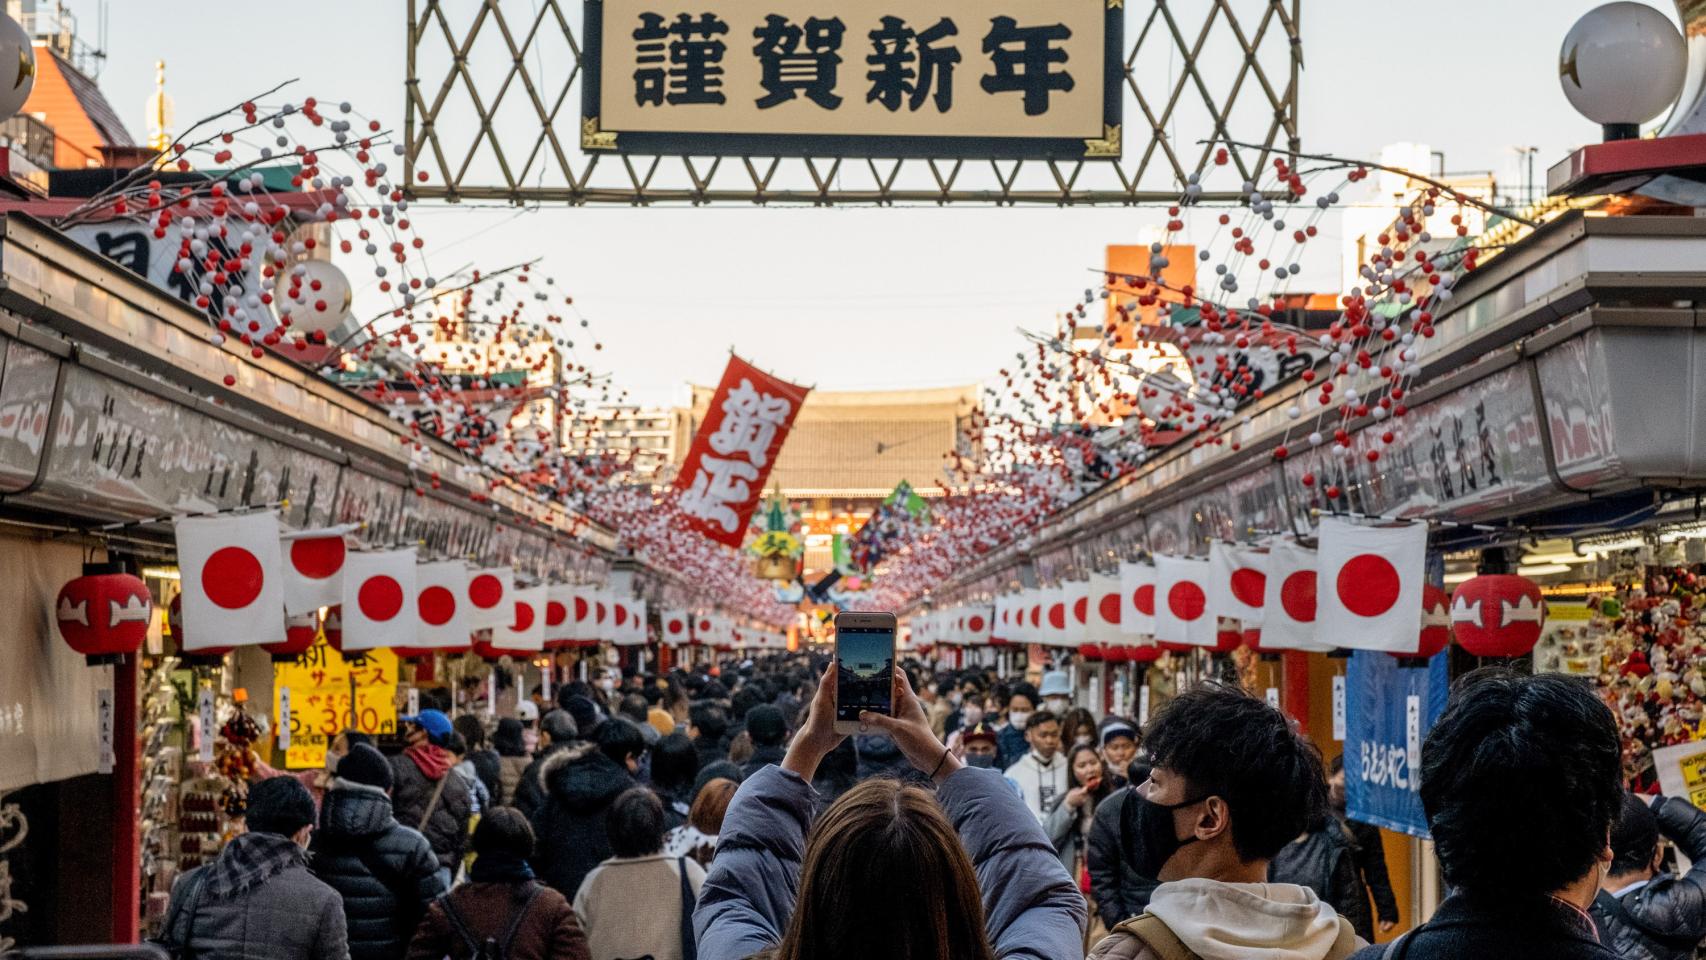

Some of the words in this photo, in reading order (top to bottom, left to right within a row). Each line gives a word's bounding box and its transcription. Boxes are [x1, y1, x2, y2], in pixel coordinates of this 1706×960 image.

[631, 12, 1075, 116] 謹賀新年
[677, 378, 791, 533] 賀正
[311, 668, 389, 688] サービス
[319, 707, 394, 735] 300円
